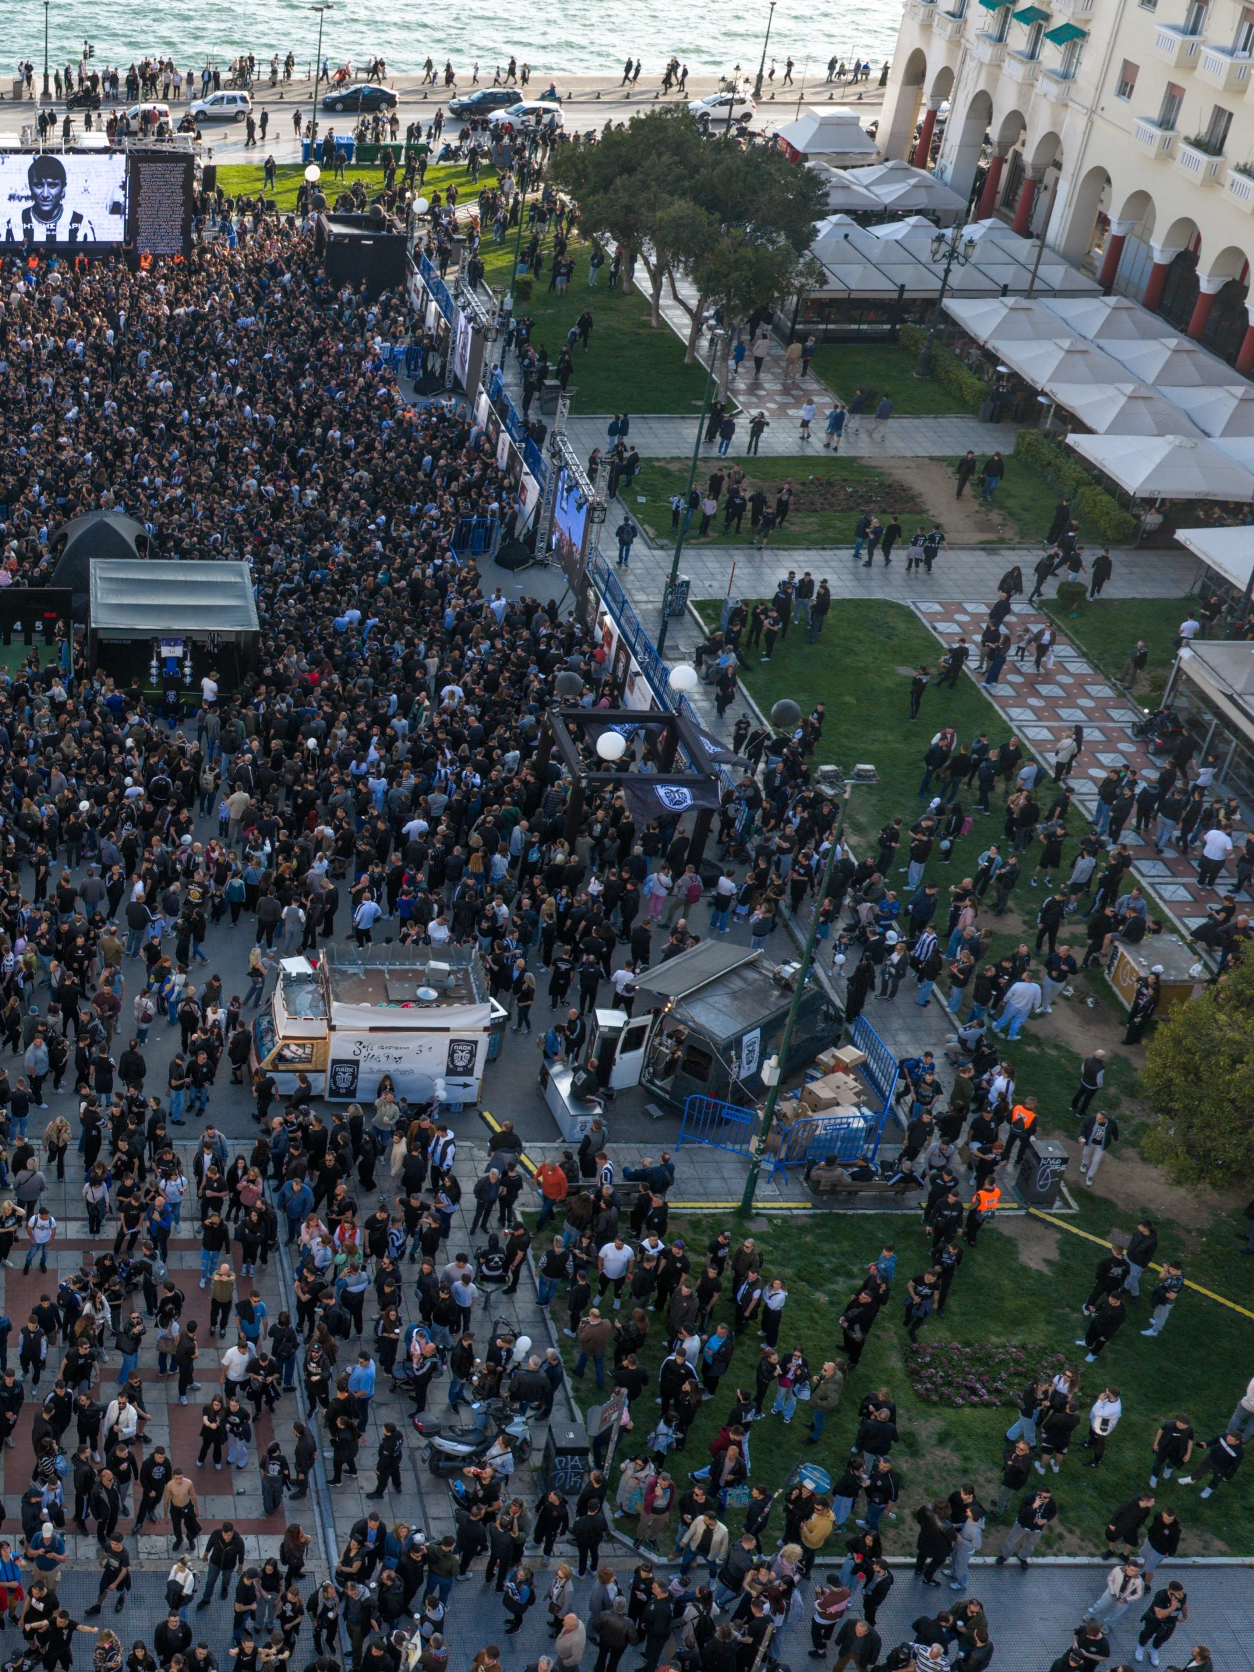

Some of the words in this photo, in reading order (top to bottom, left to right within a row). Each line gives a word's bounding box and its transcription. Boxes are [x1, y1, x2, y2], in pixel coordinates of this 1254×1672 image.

[13, 620, 22, 631] 4
[34, 620, 43, 631] 5
[352, 1040, 376, 1057] Soft
